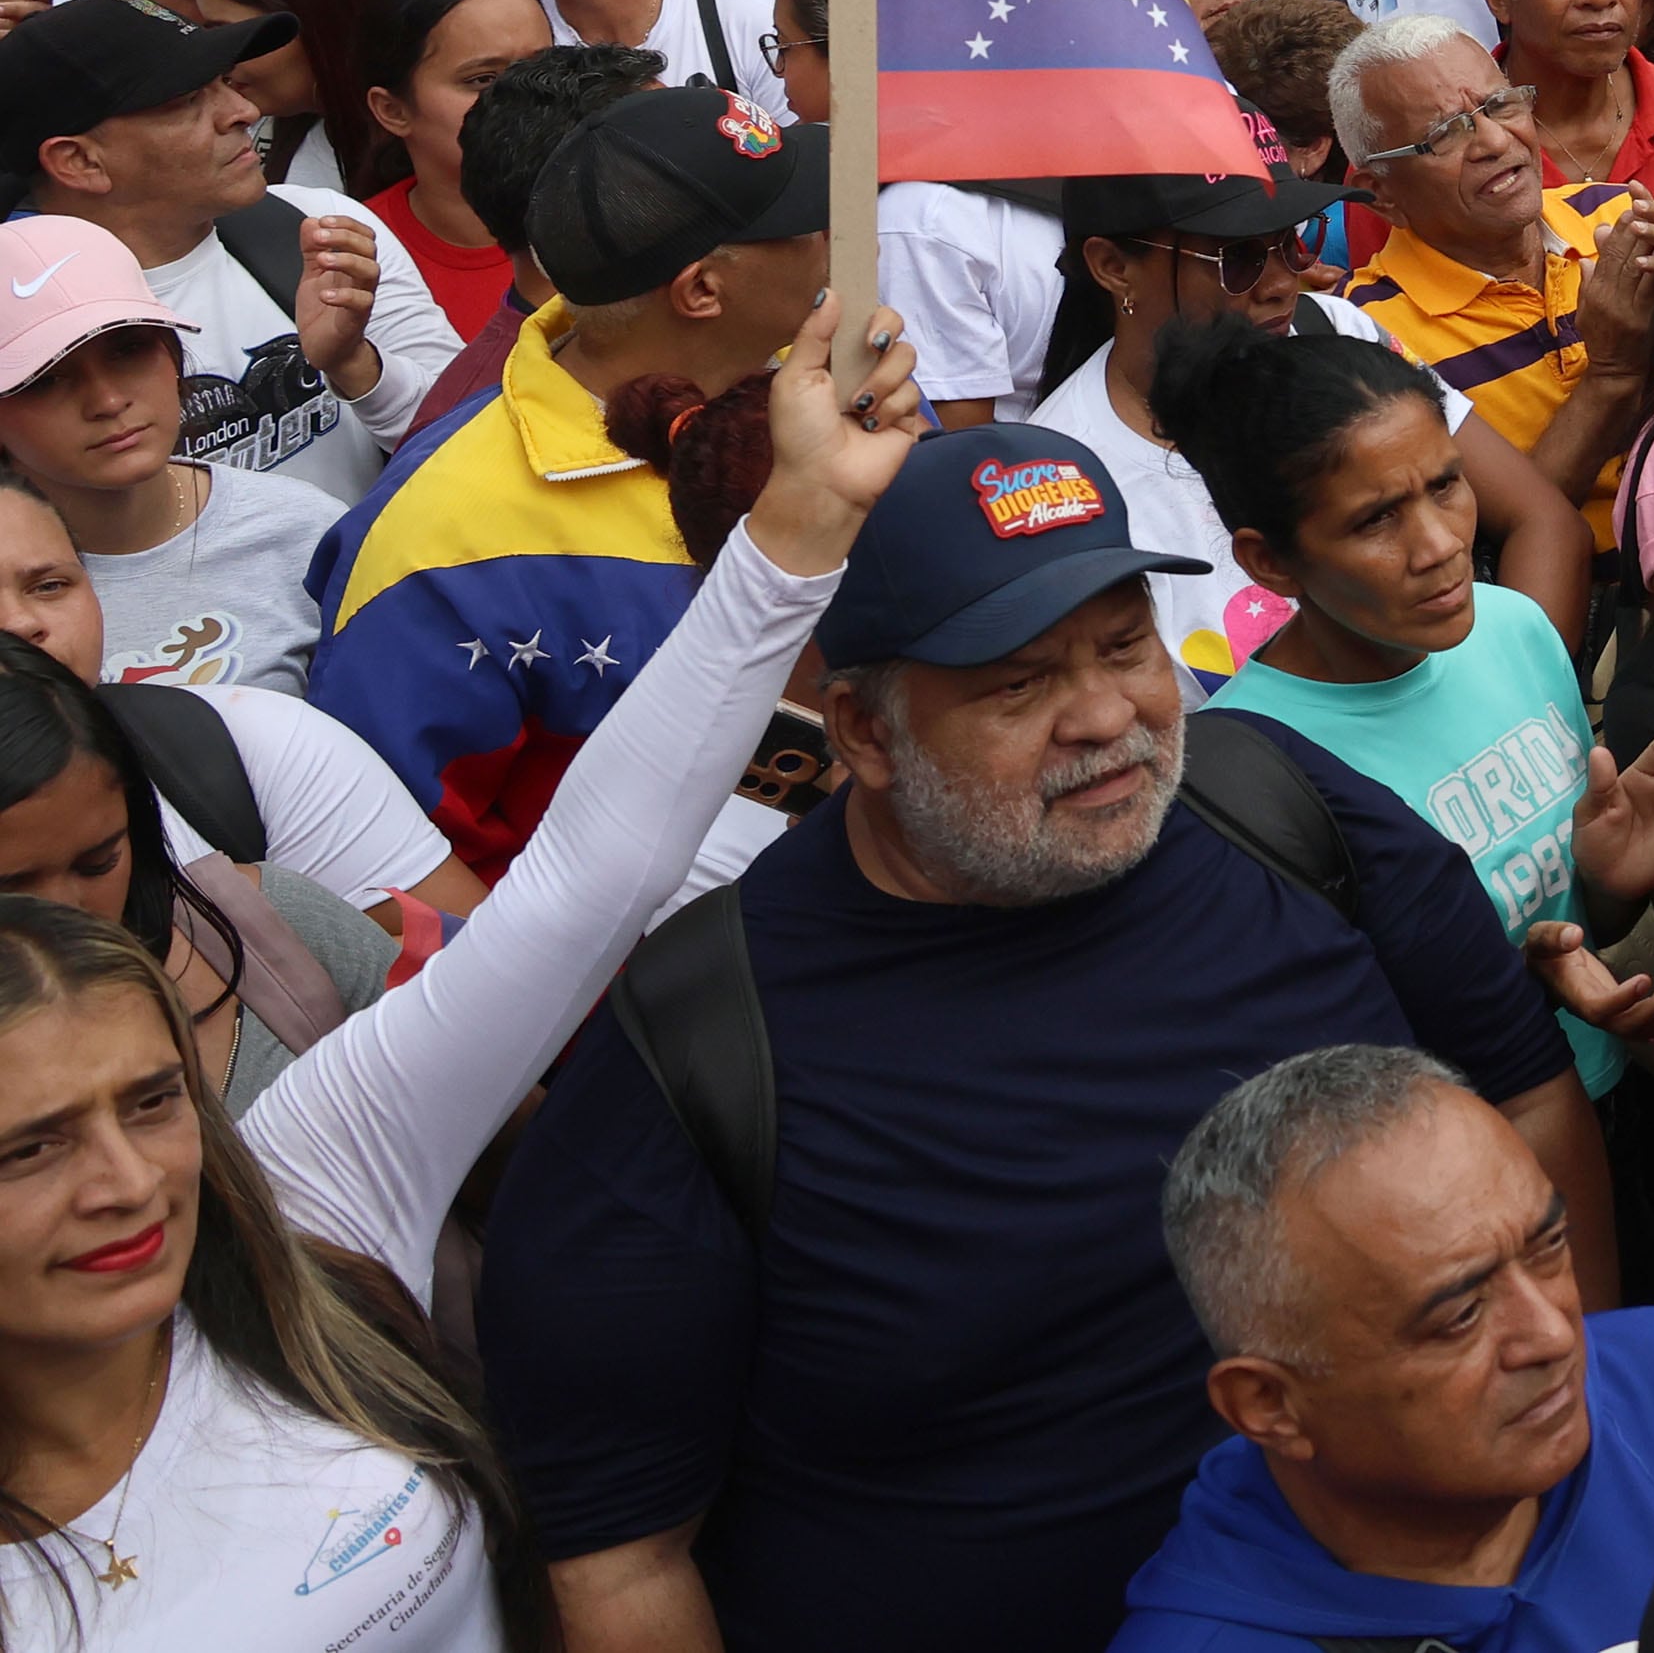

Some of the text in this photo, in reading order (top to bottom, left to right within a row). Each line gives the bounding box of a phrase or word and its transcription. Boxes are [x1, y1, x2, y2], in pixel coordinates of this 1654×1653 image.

[184, 416, 252, 457] London
[980, 463, 1060, 505] Sucre
[989, 475, 1098, 524] DIOGENES
[1028, 497, 1087, 530] Alcalde
[1424, 699, 1590, 862] ORIDA
[328, 1491, 412, 1572] CUADRANTES
[326, 1596, 407, 1653] Secretaria
